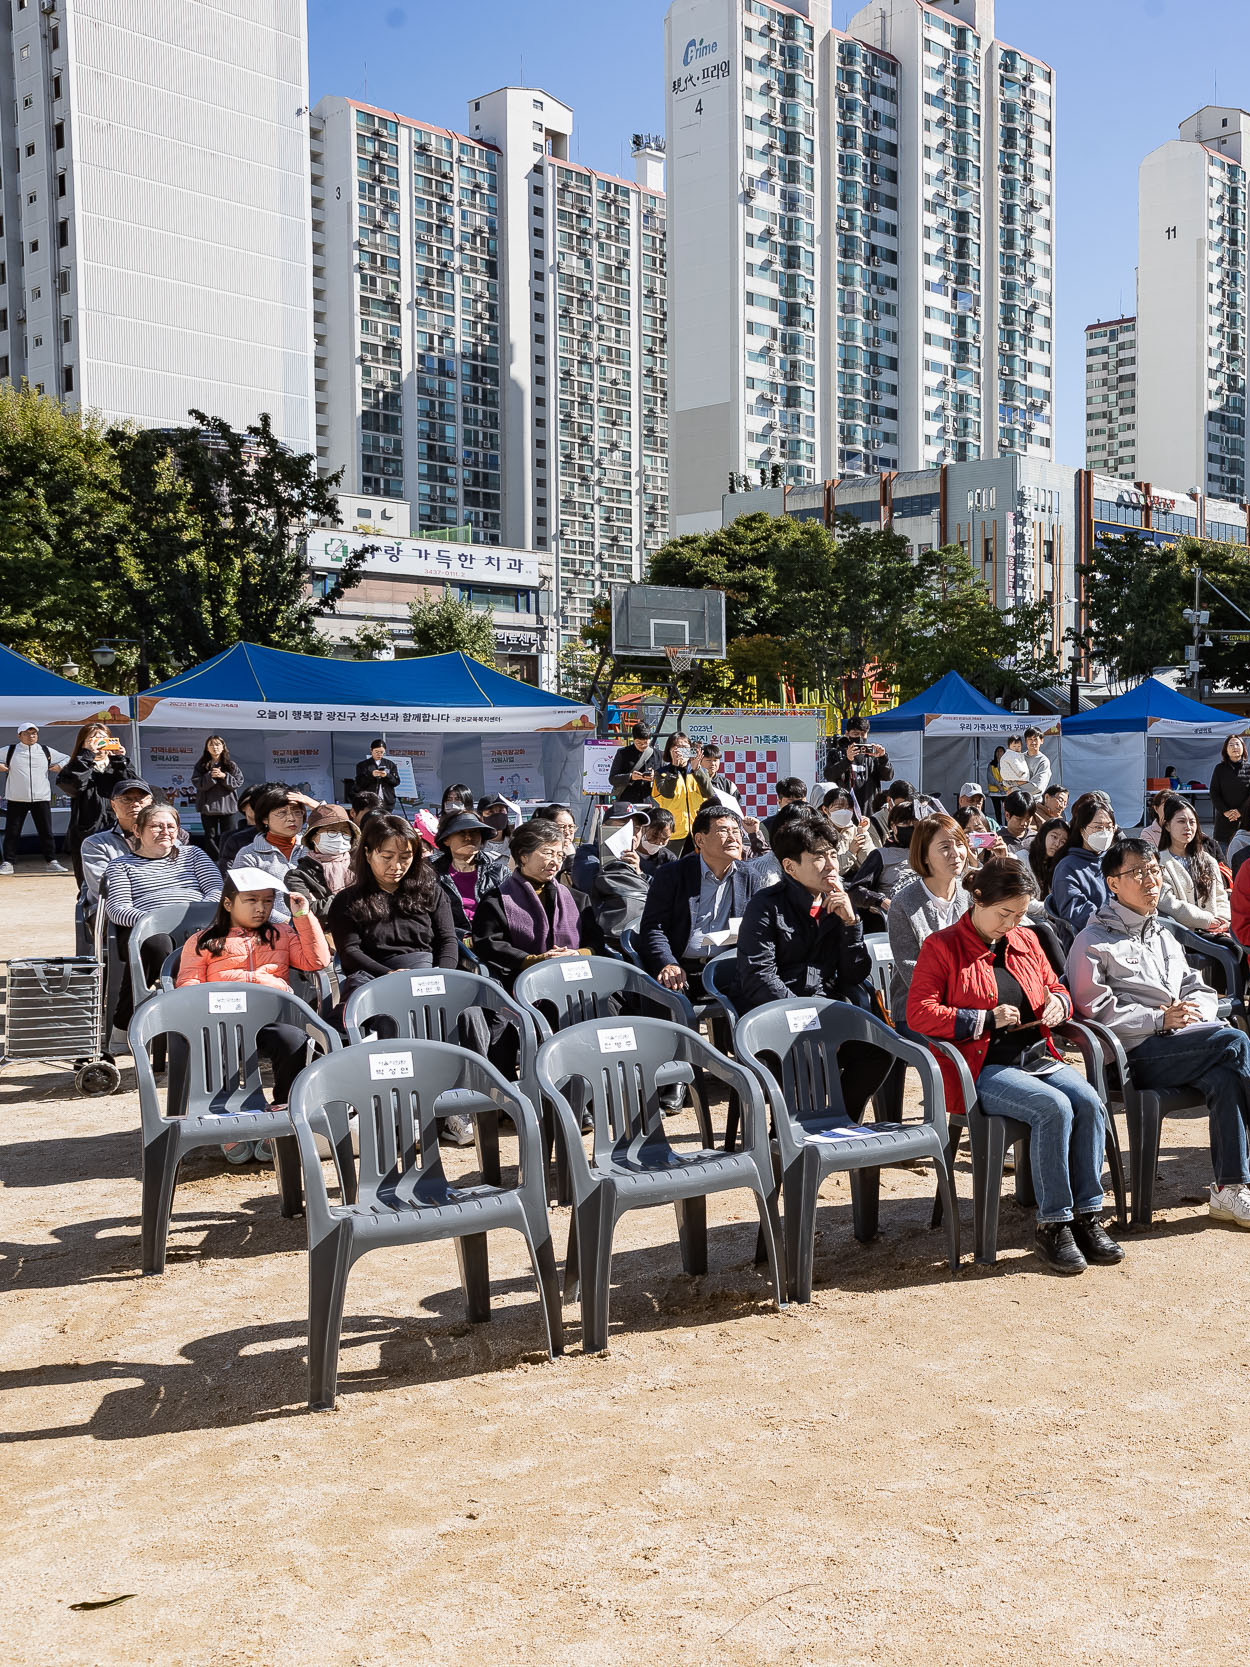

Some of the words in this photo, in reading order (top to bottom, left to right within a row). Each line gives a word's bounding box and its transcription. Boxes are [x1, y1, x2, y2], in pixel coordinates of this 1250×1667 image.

[695, 98, 703, 115] 4
[335, 186, 342, 200] 3
[1165, 225, 1177, 240] 11
[411, 547, 475, 570] 가득한
[484, 556, 524, 574] 치과
[494, 630, 541, 649] 의료센터
[256, 709, 288, 720] 오늘이
[292, 710, 324, 721] 행복할
[326, 711, 357, 721] 광진구
[359, 712, 399, 722] 청소년과
[402, 712, 450, 723] 함께합니다
[688, 725, 713, 734] 2023년
[959, 723, 972, 731] 우리
[973, 723, 999, 732] 가족사진
[754, 735, 788, 744] 가족축제
[151, 746, 193, 754] 지역네트워크
